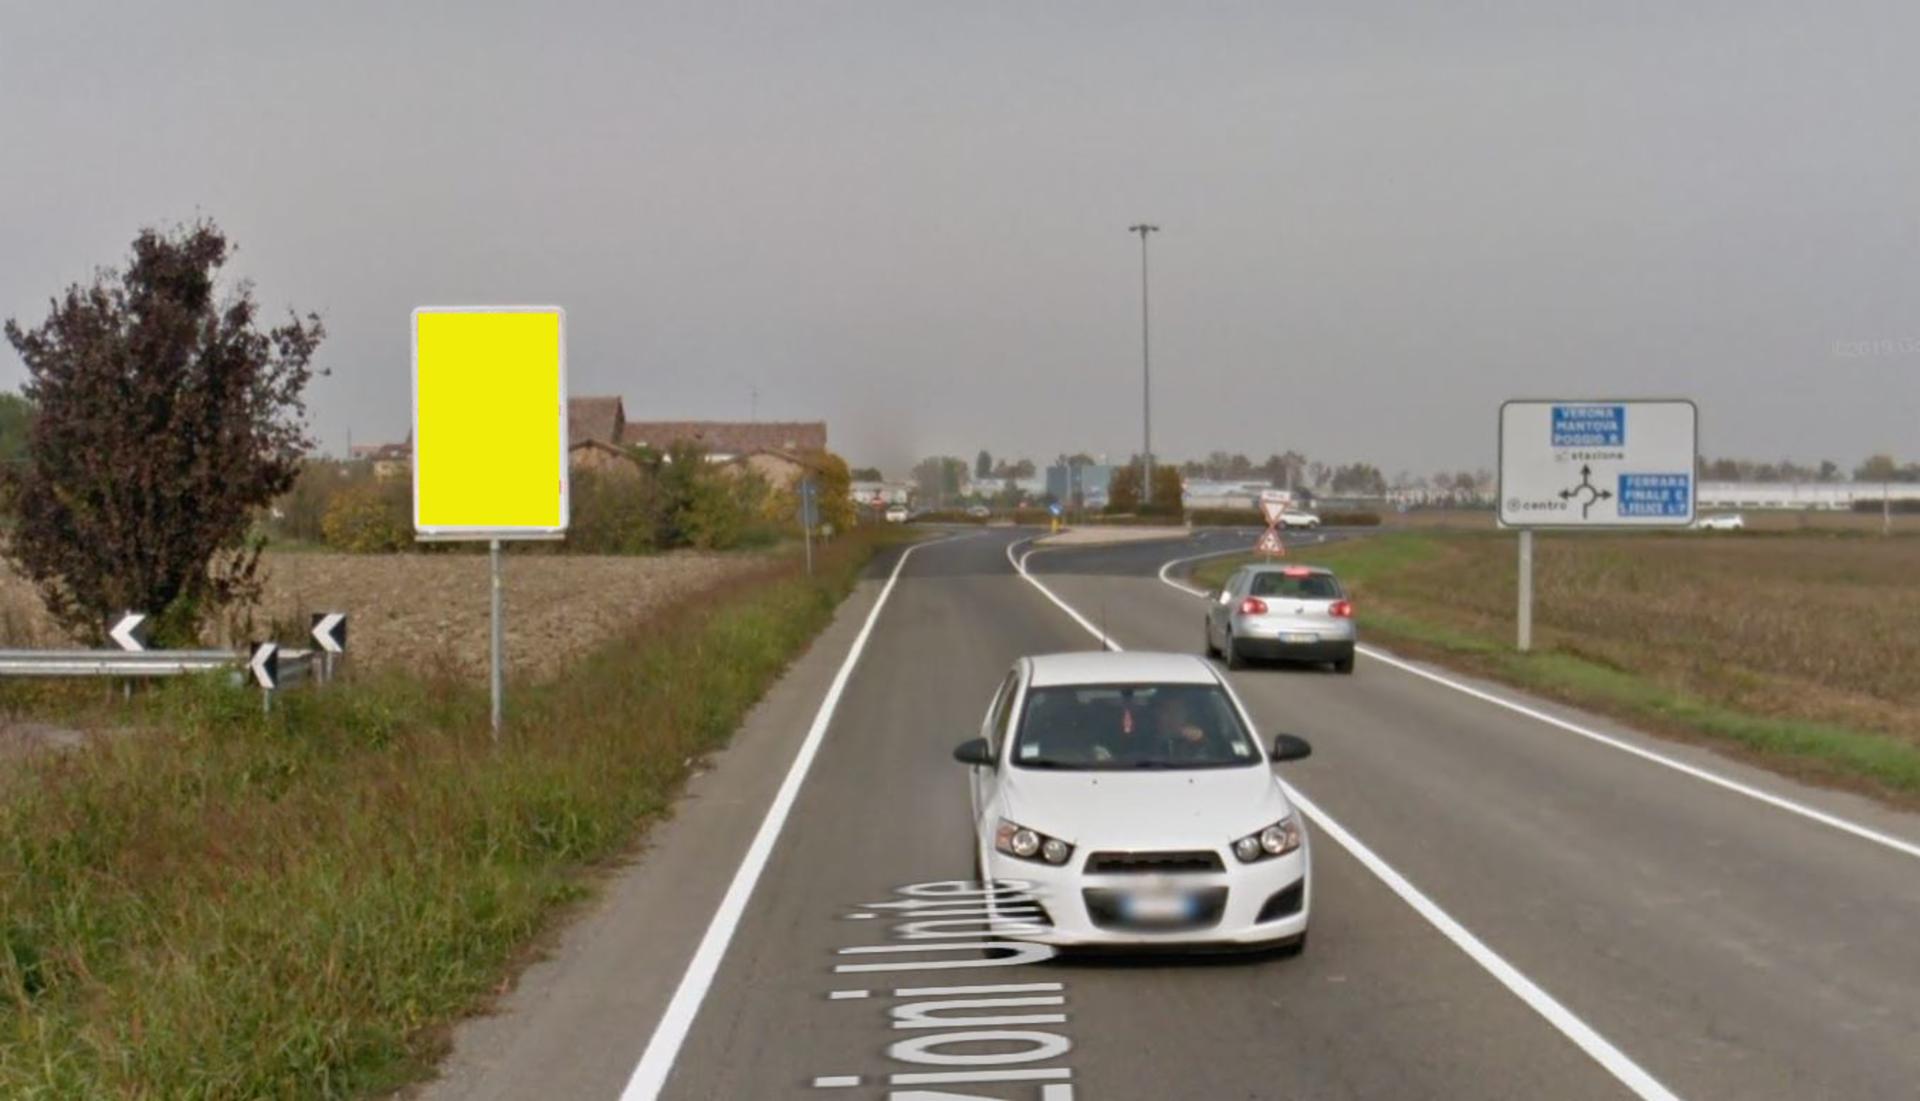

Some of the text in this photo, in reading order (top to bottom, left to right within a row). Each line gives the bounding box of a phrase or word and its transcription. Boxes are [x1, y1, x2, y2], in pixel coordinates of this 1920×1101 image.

[1556, 421, 1617, 432] MANTOVA
[1571, 451, 1624, 461] stazione
[1522, 500, 1567, 511] centro
